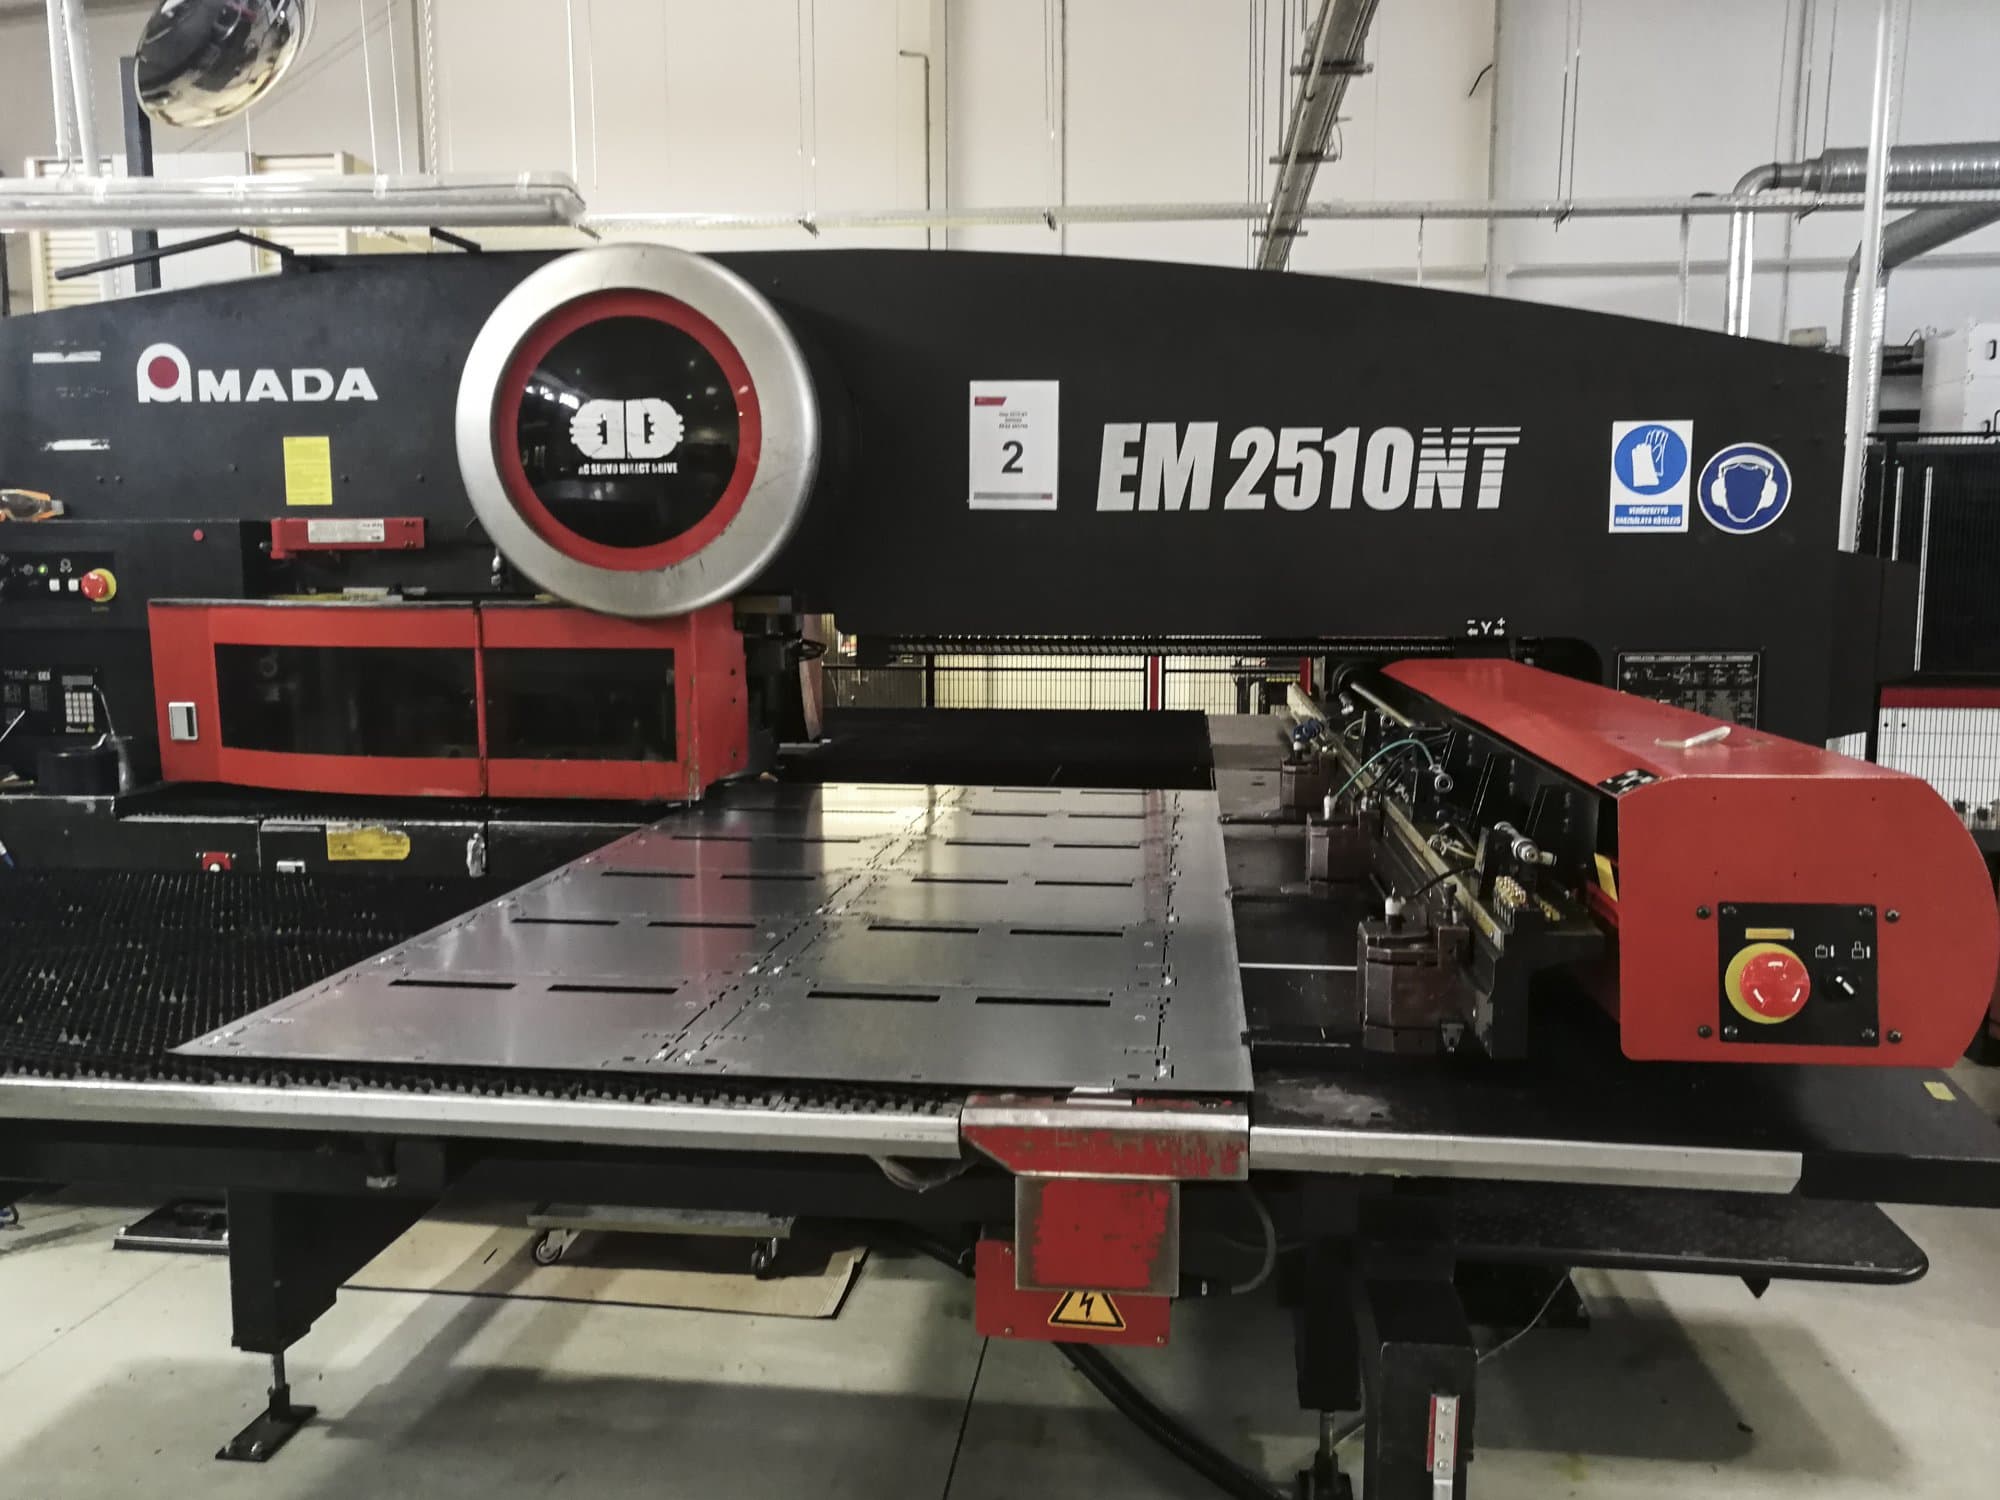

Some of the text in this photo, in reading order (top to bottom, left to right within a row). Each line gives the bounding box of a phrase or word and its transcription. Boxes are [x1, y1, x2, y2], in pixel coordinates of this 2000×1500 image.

[137, 343, 379, 404] AMADA
[651, 462, 678, 475] DRIVE
[1001, 440, 1024, 474] 2
[1096, 421, 1522, 512] EM 2510NT
[1480, 620, 1492, 635] Y
